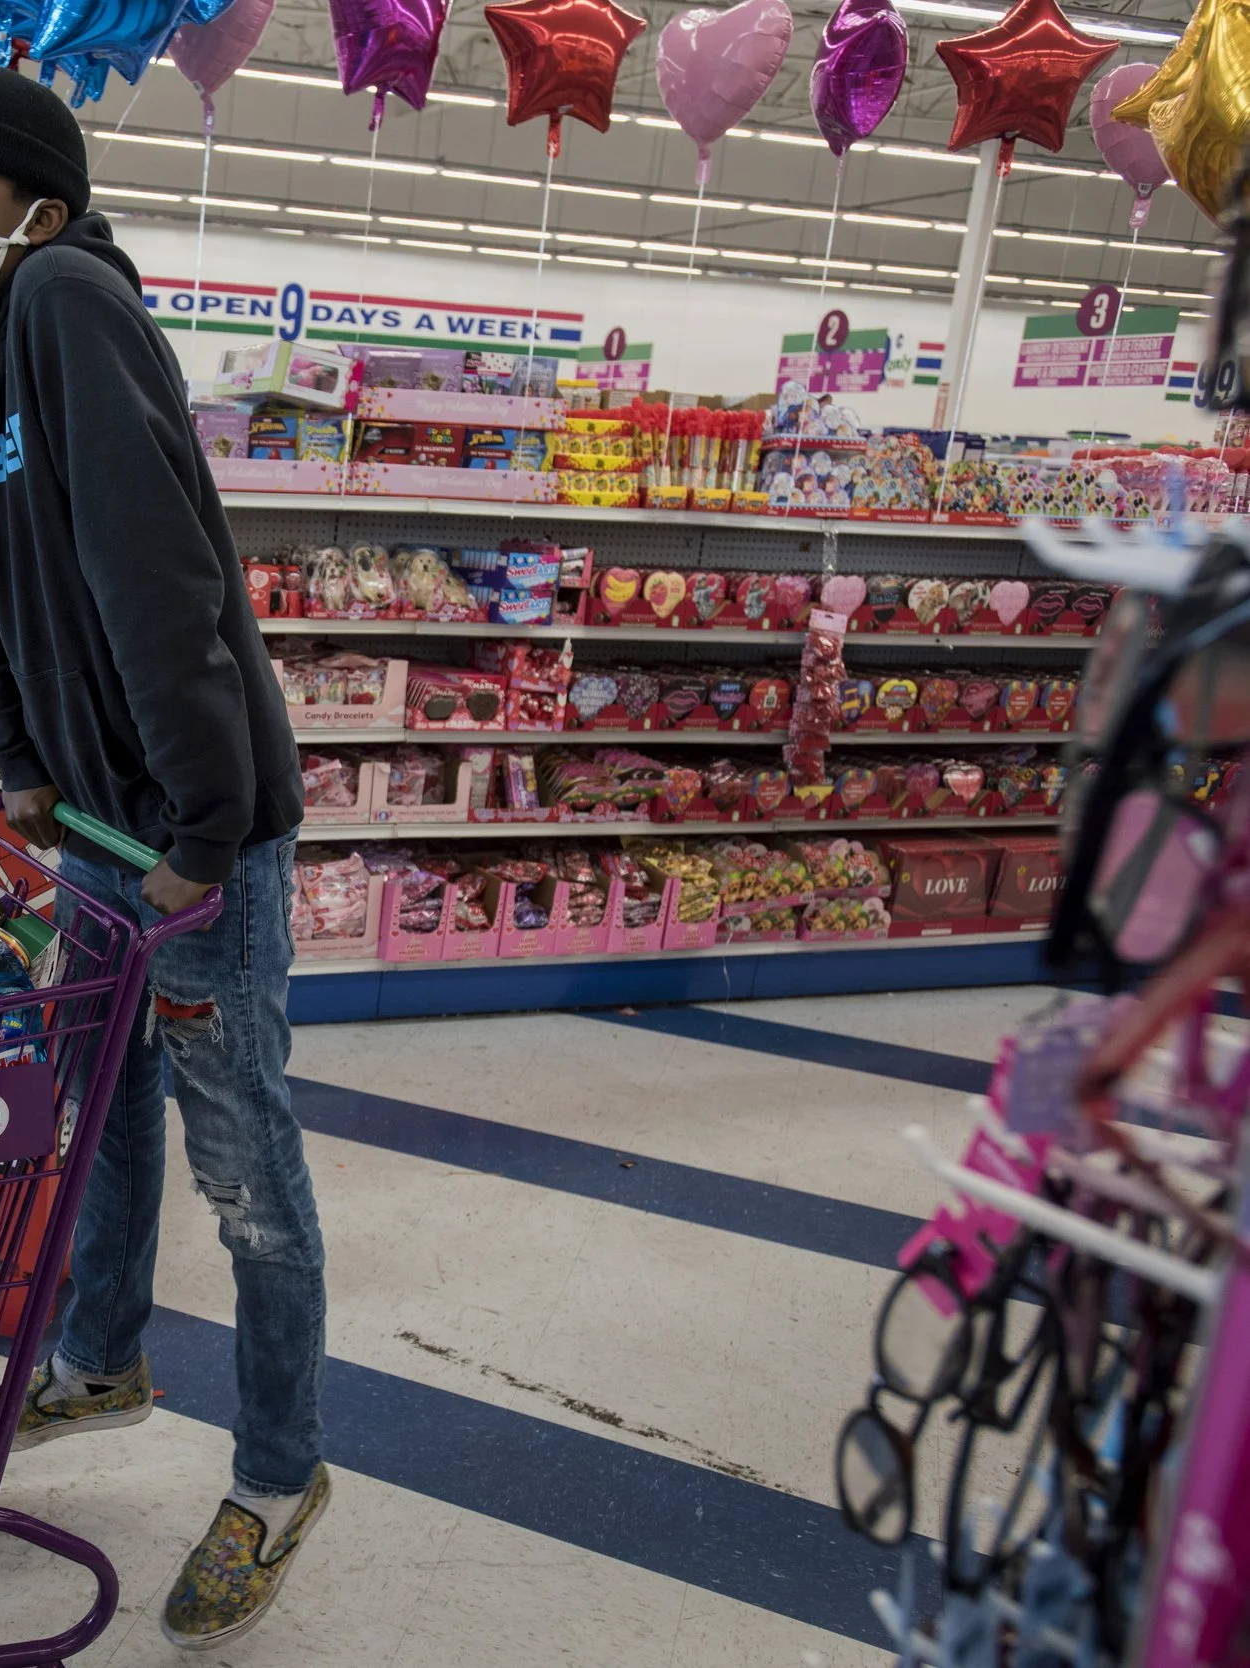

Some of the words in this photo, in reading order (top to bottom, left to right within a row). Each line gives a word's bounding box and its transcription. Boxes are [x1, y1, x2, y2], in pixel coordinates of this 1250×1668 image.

[170, 294, 272, 318] OPEN
[279, 283, 304, 341] 9
[311, 304, 401, 328] DAYS
[415, 313, 435, 331] A
[446, 316, 541, 340] WEEK
[1090, 293, 1109, 329] 3
[610, 330, 620, 358] 1
[824, 314, 840, 346] 2
[305, 711, 331, 722] Candy
[333, 711, 374, 721] Bracelets
[924, 877, 971, 895] LOVE
